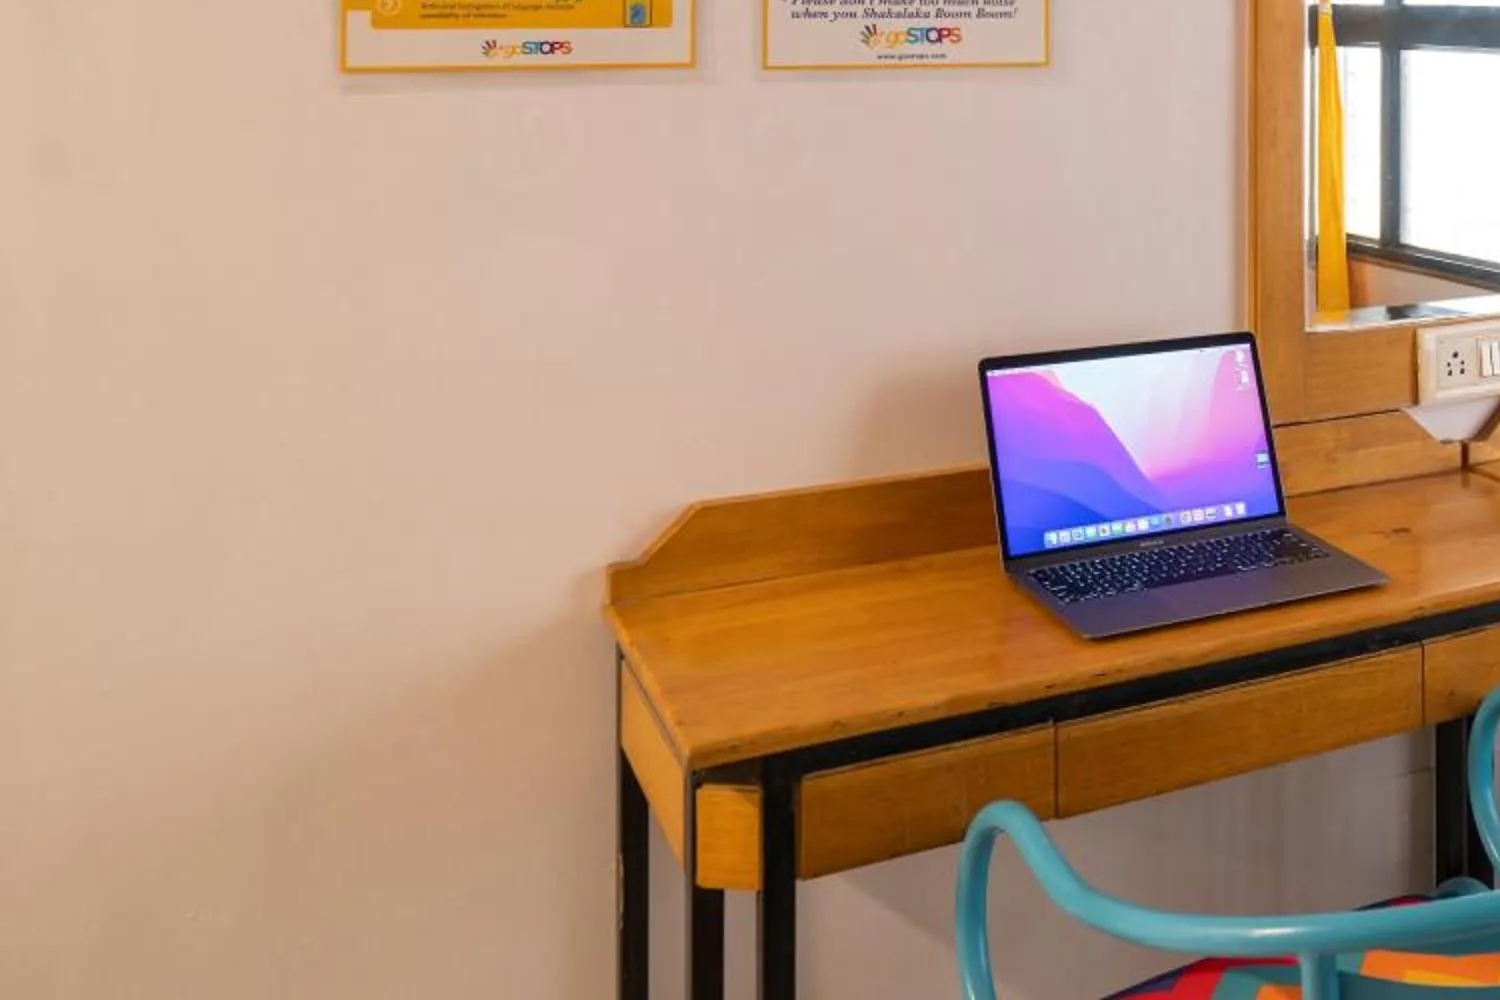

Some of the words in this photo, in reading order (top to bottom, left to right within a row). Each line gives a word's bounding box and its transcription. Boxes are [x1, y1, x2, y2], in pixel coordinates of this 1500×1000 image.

[790, 8, 829, 19] when
[831, 10, 857, 23] you
[861, 7, 931, 19] Shakalaka
[934, 8, 972, 19] Boom
